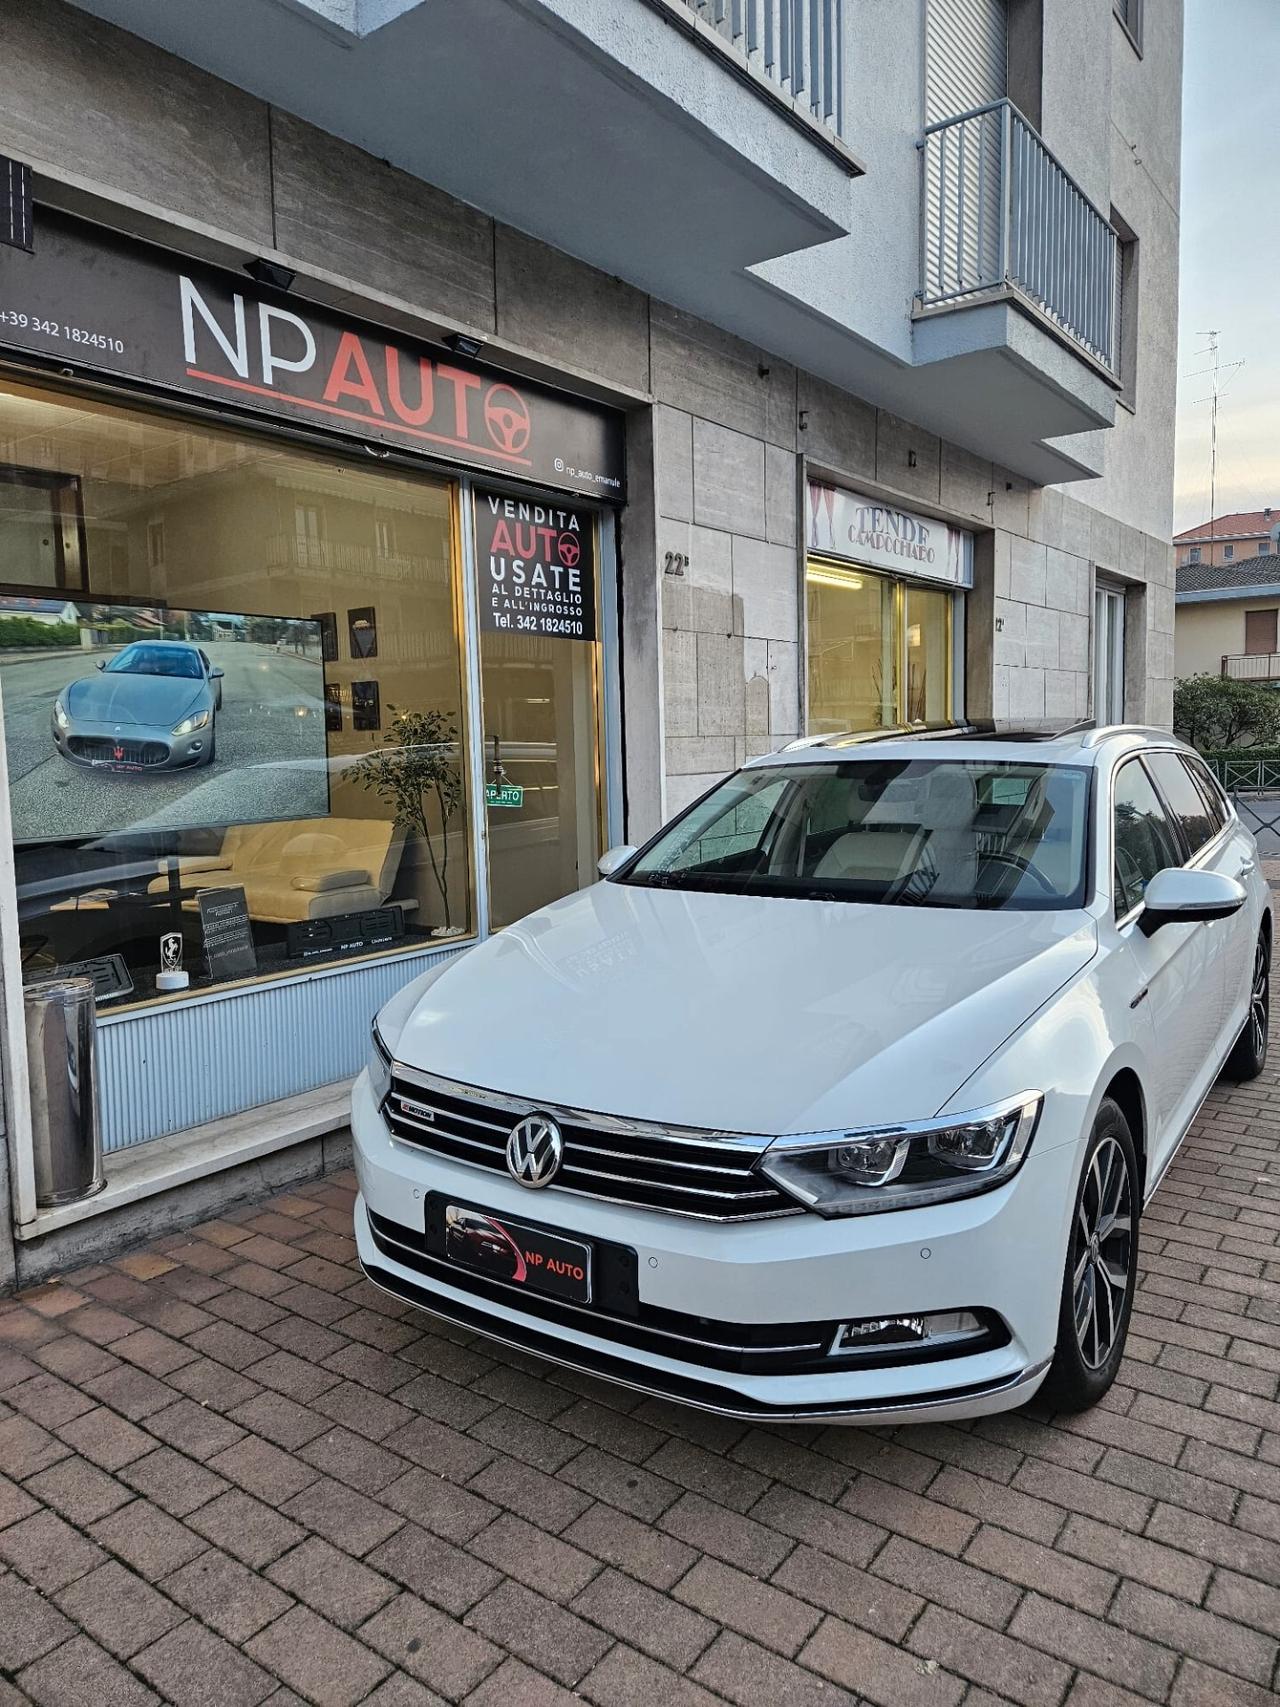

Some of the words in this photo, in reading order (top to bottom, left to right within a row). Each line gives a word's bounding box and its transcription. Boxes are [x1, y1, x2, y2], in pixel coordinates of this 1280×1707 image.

[0, 311, 28, 328] +39
[32, 317, 60, 337] 342
[63, 326, 124, 353] 1824510
[488, 496, 580, 531] VENDITA
[490, 556, 581, 592] USATE
[492, 583, 508, 595] AL
[515, 586, 582, 604] DETTAGLIO
[492, 597, 498, 607] E
[503, 600, 583, 617] ALL'INGROSSO
[493, 612, 514, 628] Tel.
[517, 615, 537, 631] 342
[540, 618, 583, 635] 1824510
[486, 789, 520, 801] APRTO
[525, 1251, 544, 1265] NP
[546, 1258, 584, 1281] AUTO
